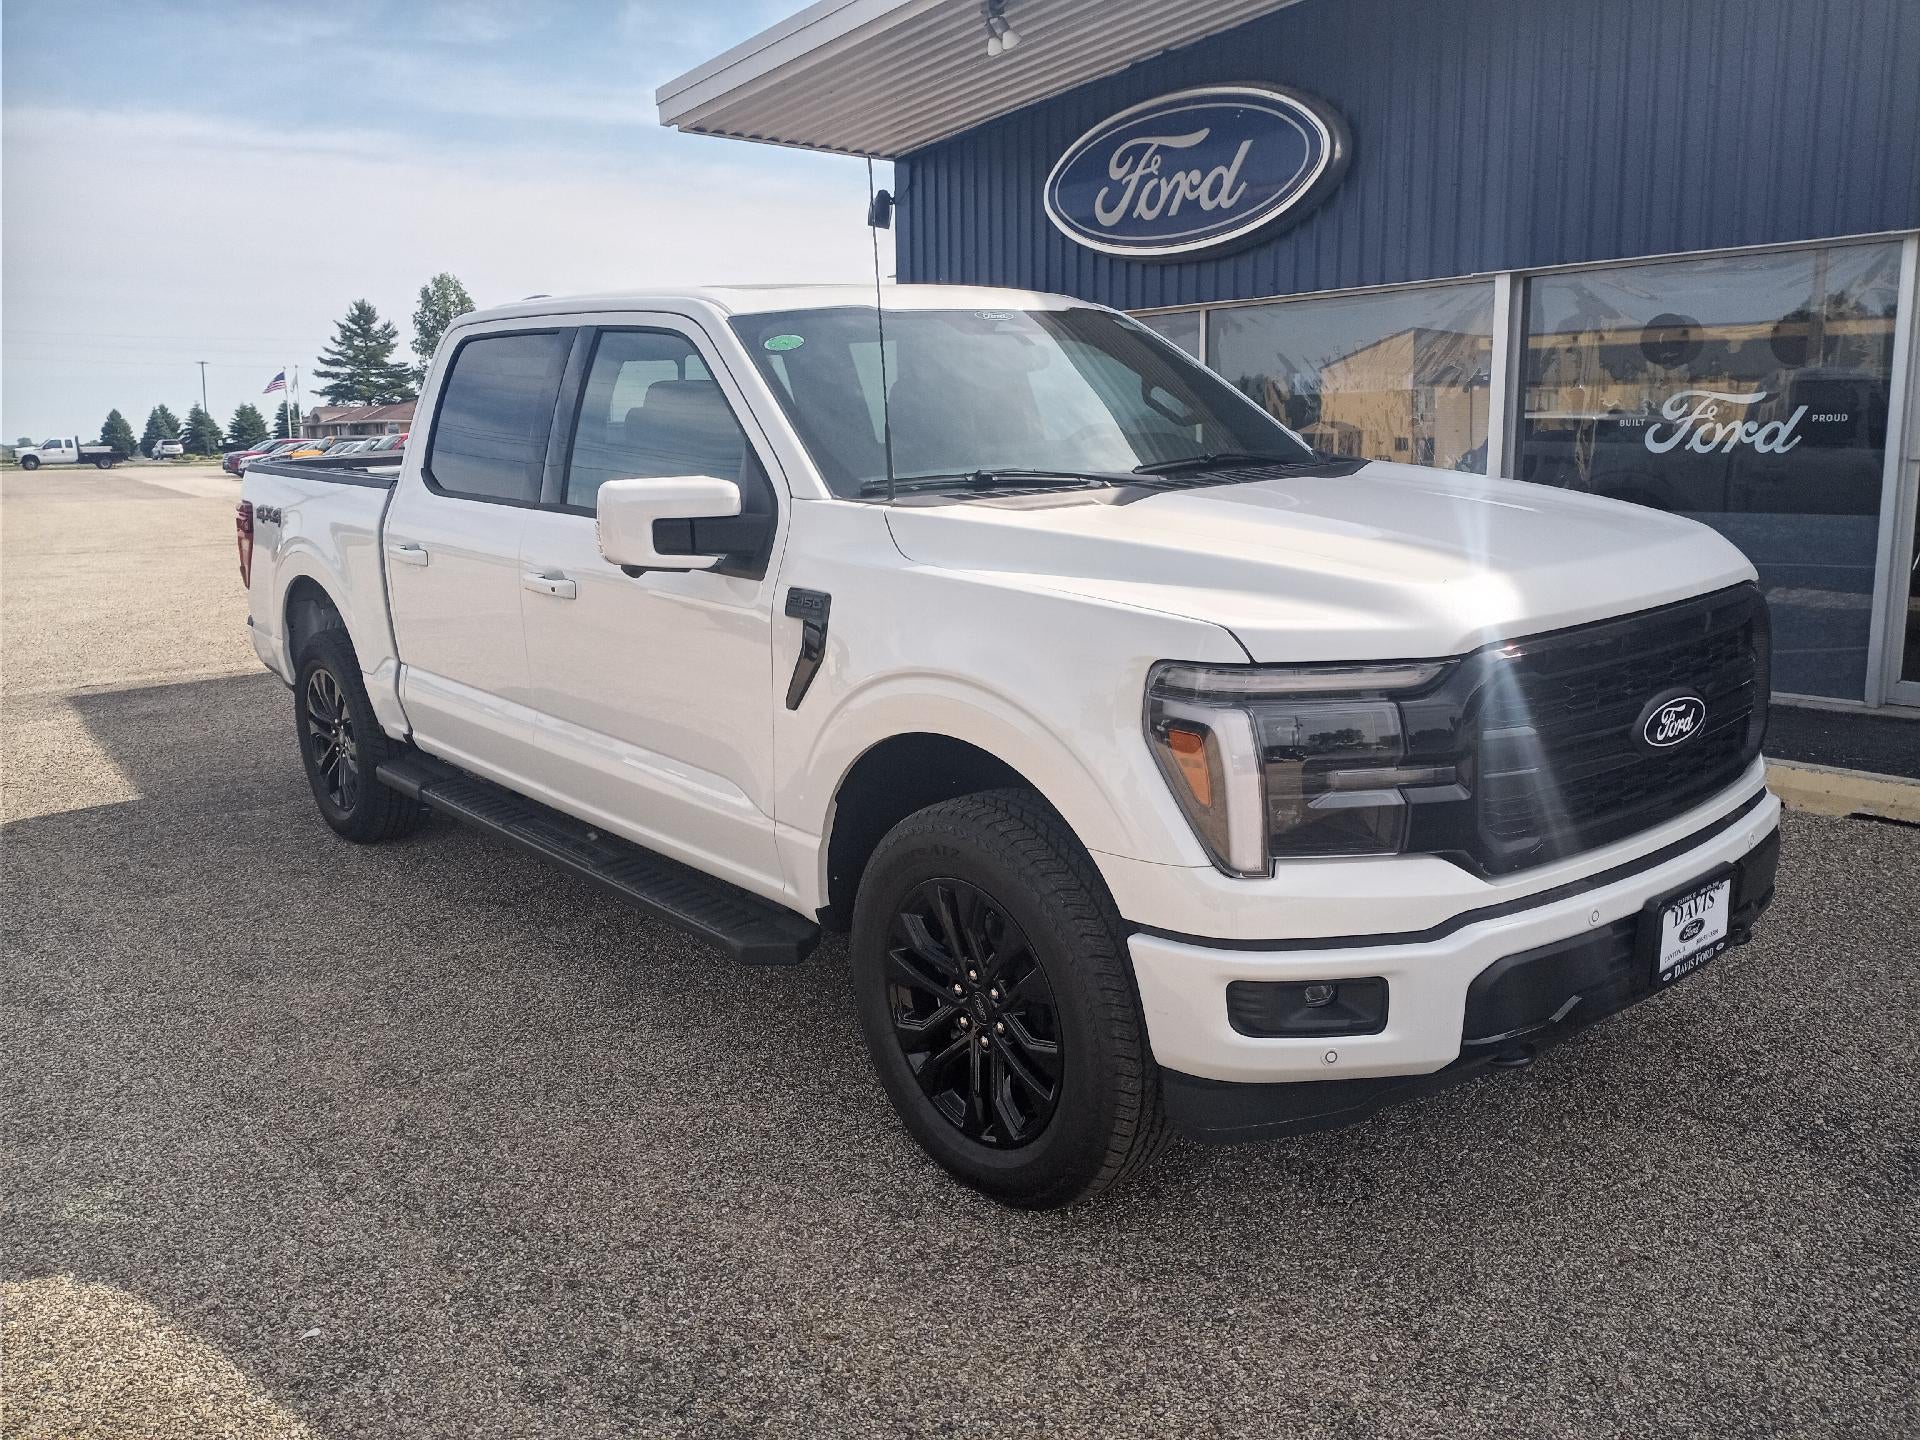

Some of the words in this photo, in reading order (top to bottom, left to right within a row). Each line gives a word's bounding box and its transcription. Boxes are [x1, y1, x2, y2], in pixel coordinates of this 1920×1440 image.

[1095, 128, 1253, 227] Ford
[1619, 418, 1646, 428] BUILT
[1645, 391, 1808, 453] Ford
[1812, 413, 1848, 423] PROUD
[1656, 703, 1695, 741] Ford
[1673, 890, 1715, 928] DAVIS
[1674, 958, 1695, 979] DAVIS
[1695, 947, 1714, 966] FORD
